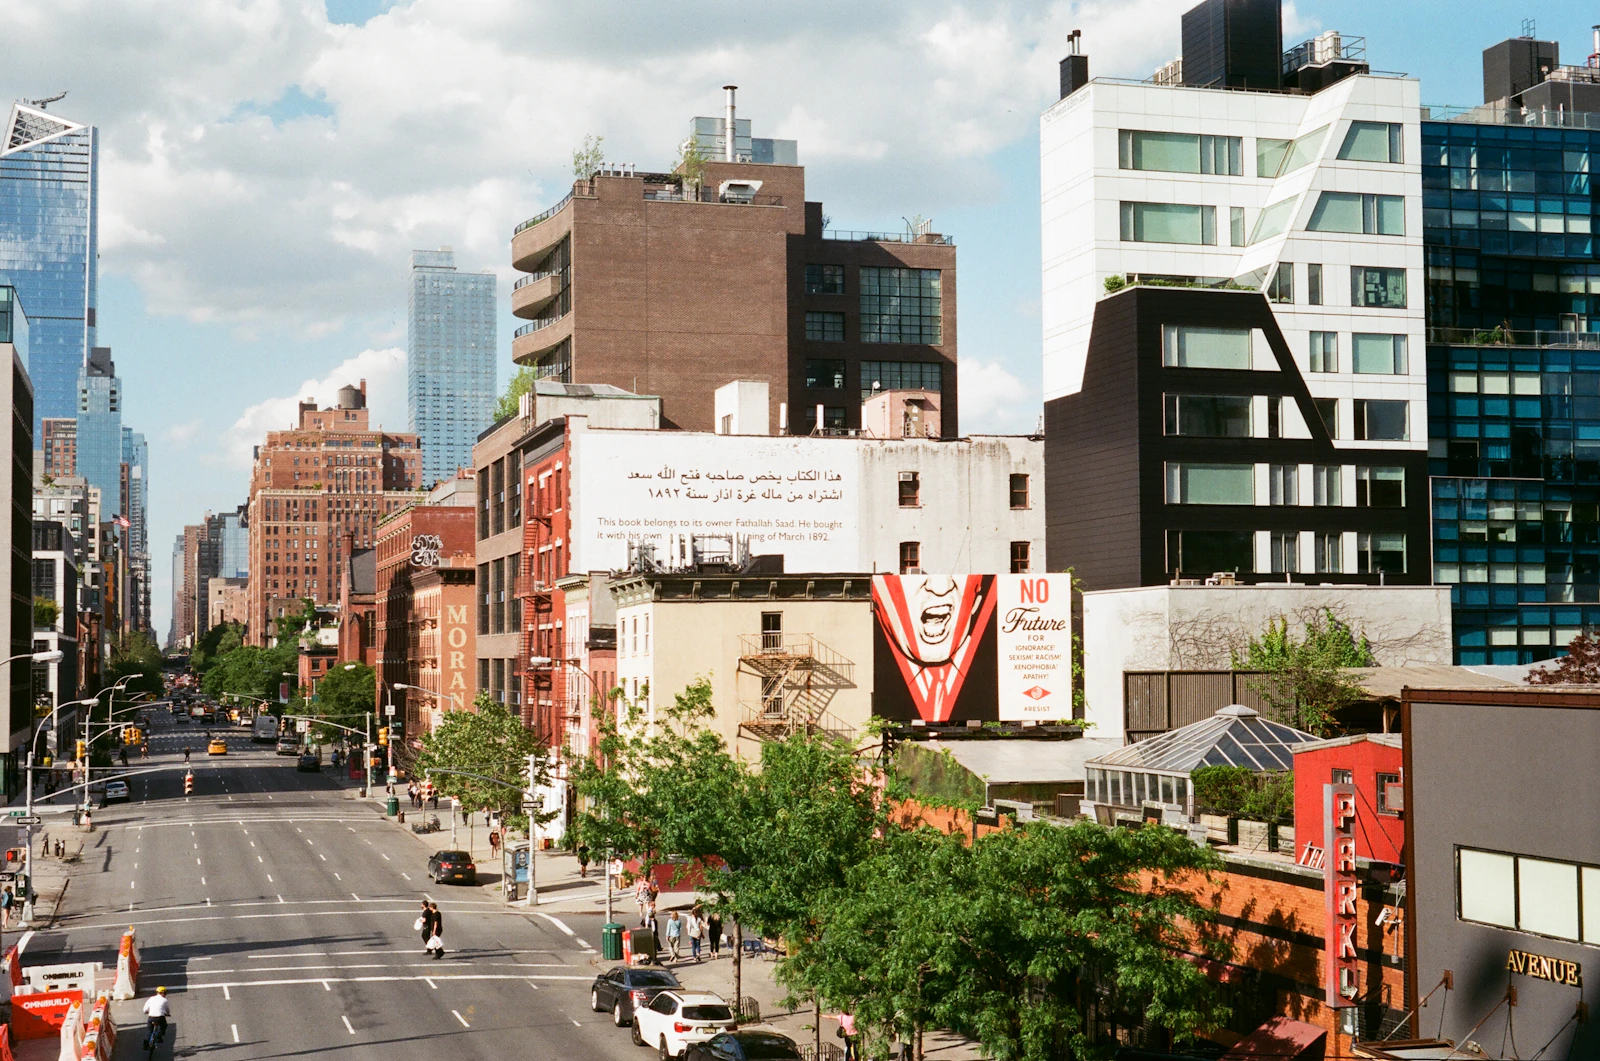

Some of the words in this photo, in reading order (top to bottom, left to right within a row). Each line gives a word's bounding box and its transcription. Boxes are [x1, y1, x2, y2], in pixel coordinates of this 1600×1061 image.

[627, 471, 653, 479] سعد
[679, 469, 701, 485] فتح
[705, 469, 744, 484] صاحبه
[749, 470, 782, 484] يخص
[786, 469, 820, 485] الكتاب
[824, 469, 842, 481] هذا
[648, 487, 680, 499] ١٨٩٢
[685, 487, 708, 499] سنة
[712, 488, 732, 503] اذار
[736, 489, 757, 503] غرة
[761, 488, 782, 499] ماله
[786, 490, 804, 502] من
[807, 489, 843, 503] اشتراه
[597, 517, 616, 526] This
[618, 518, 642, 527] book
[644, 518, 677, 529] belongs
[692, 518, 703, 527] its
[736, 518, 773, 528] Fathallah
[775, 518, 797, 528] Saad.
[798, 519, 811, 528] He
[813, 520, 843, 530] bought
[597, 531, 604, 539] it
[606, 531, 626, 539] with
[628, 531, 641, 540] his
[767, 532, 777, 541] of
[779, 532, 805, 541] March
[808, 532, 830, 541] 1892.
[1020, 578, 1049, 604] NO
[1001, 607, 1066, 634] Future
[1027, 634, 1045, 642] FOR
[446, 605, 469, 709] MORAN
[1334, 793, 1357, 959] PARK
[1505, 950, 1579, 986] AVENUE
[42, 971, 84, 981] OMNIBUILD
[23, 998, 71, 1010] OMNIBUILD
